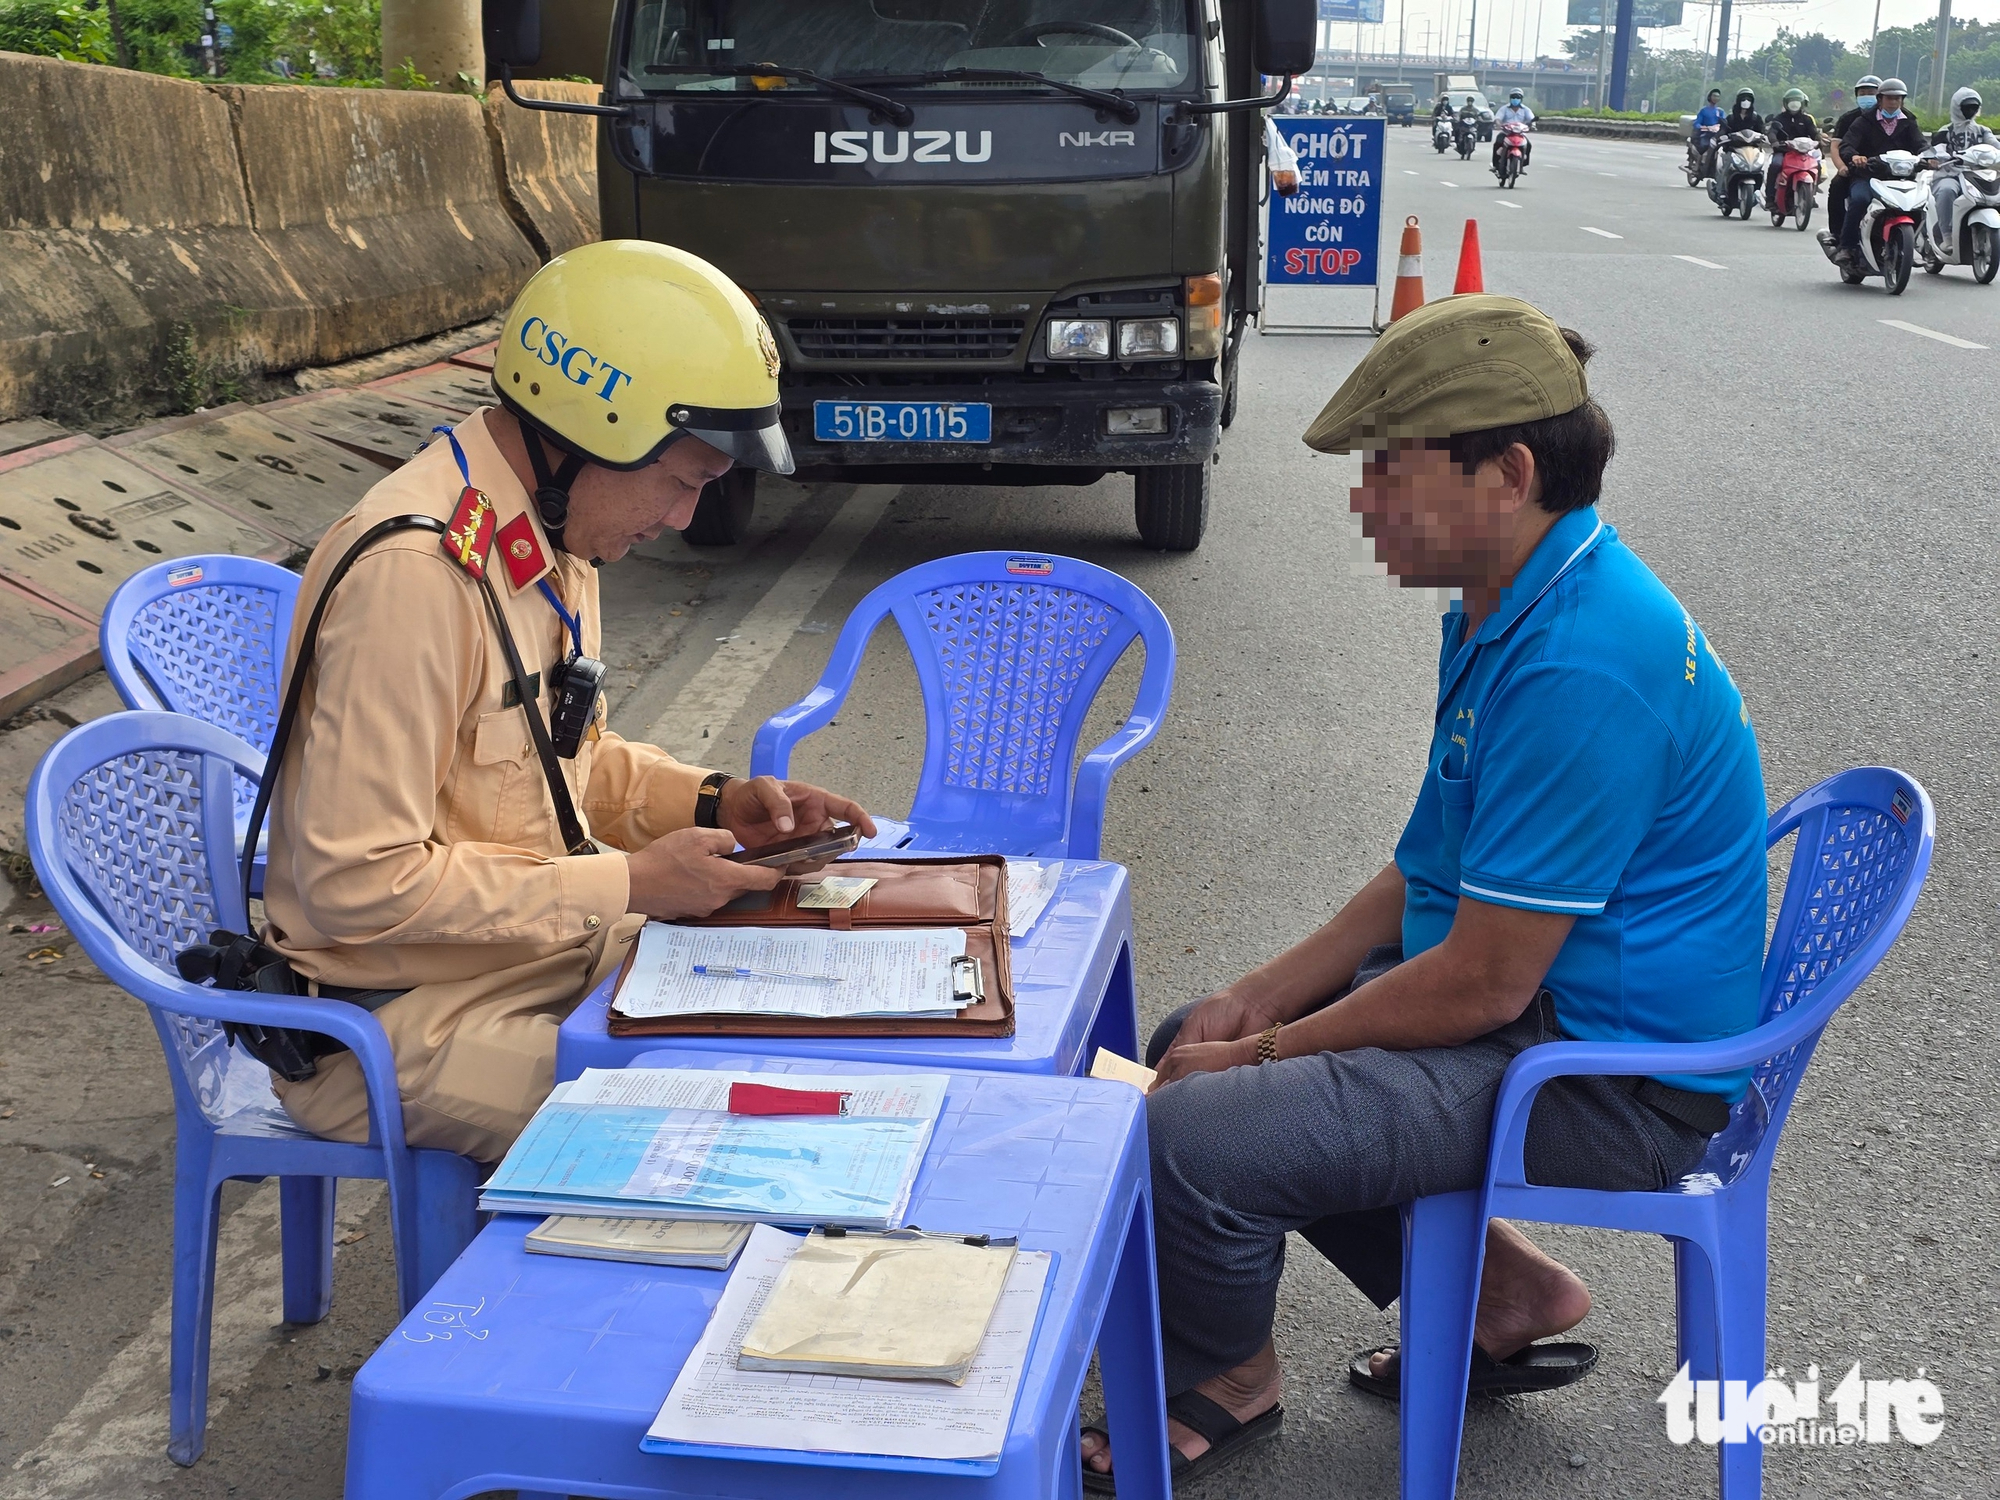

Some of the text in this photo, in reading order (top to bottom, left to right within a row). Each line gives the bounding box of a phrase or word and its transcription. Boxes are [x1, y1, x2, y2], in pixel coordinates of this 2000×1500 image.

[814, 130, 991, 163] ISUZU
[1060, 132, 1134, 148] NKR
[1290, 124, 1367, 159] CHỐT
[1291, 162, 1371, 186] ỂM TRA
[1285, 191, 1365, 217] NỒNG ĐỘ
[1305, 219, 1342, 242] CỒN
[1283, 248, 1361, 275] STOP
[520, 315, 632, 403] CSGT
[834, 402, 967, 439] 51B-0115
[1684, 656, 1697, 686] XE
